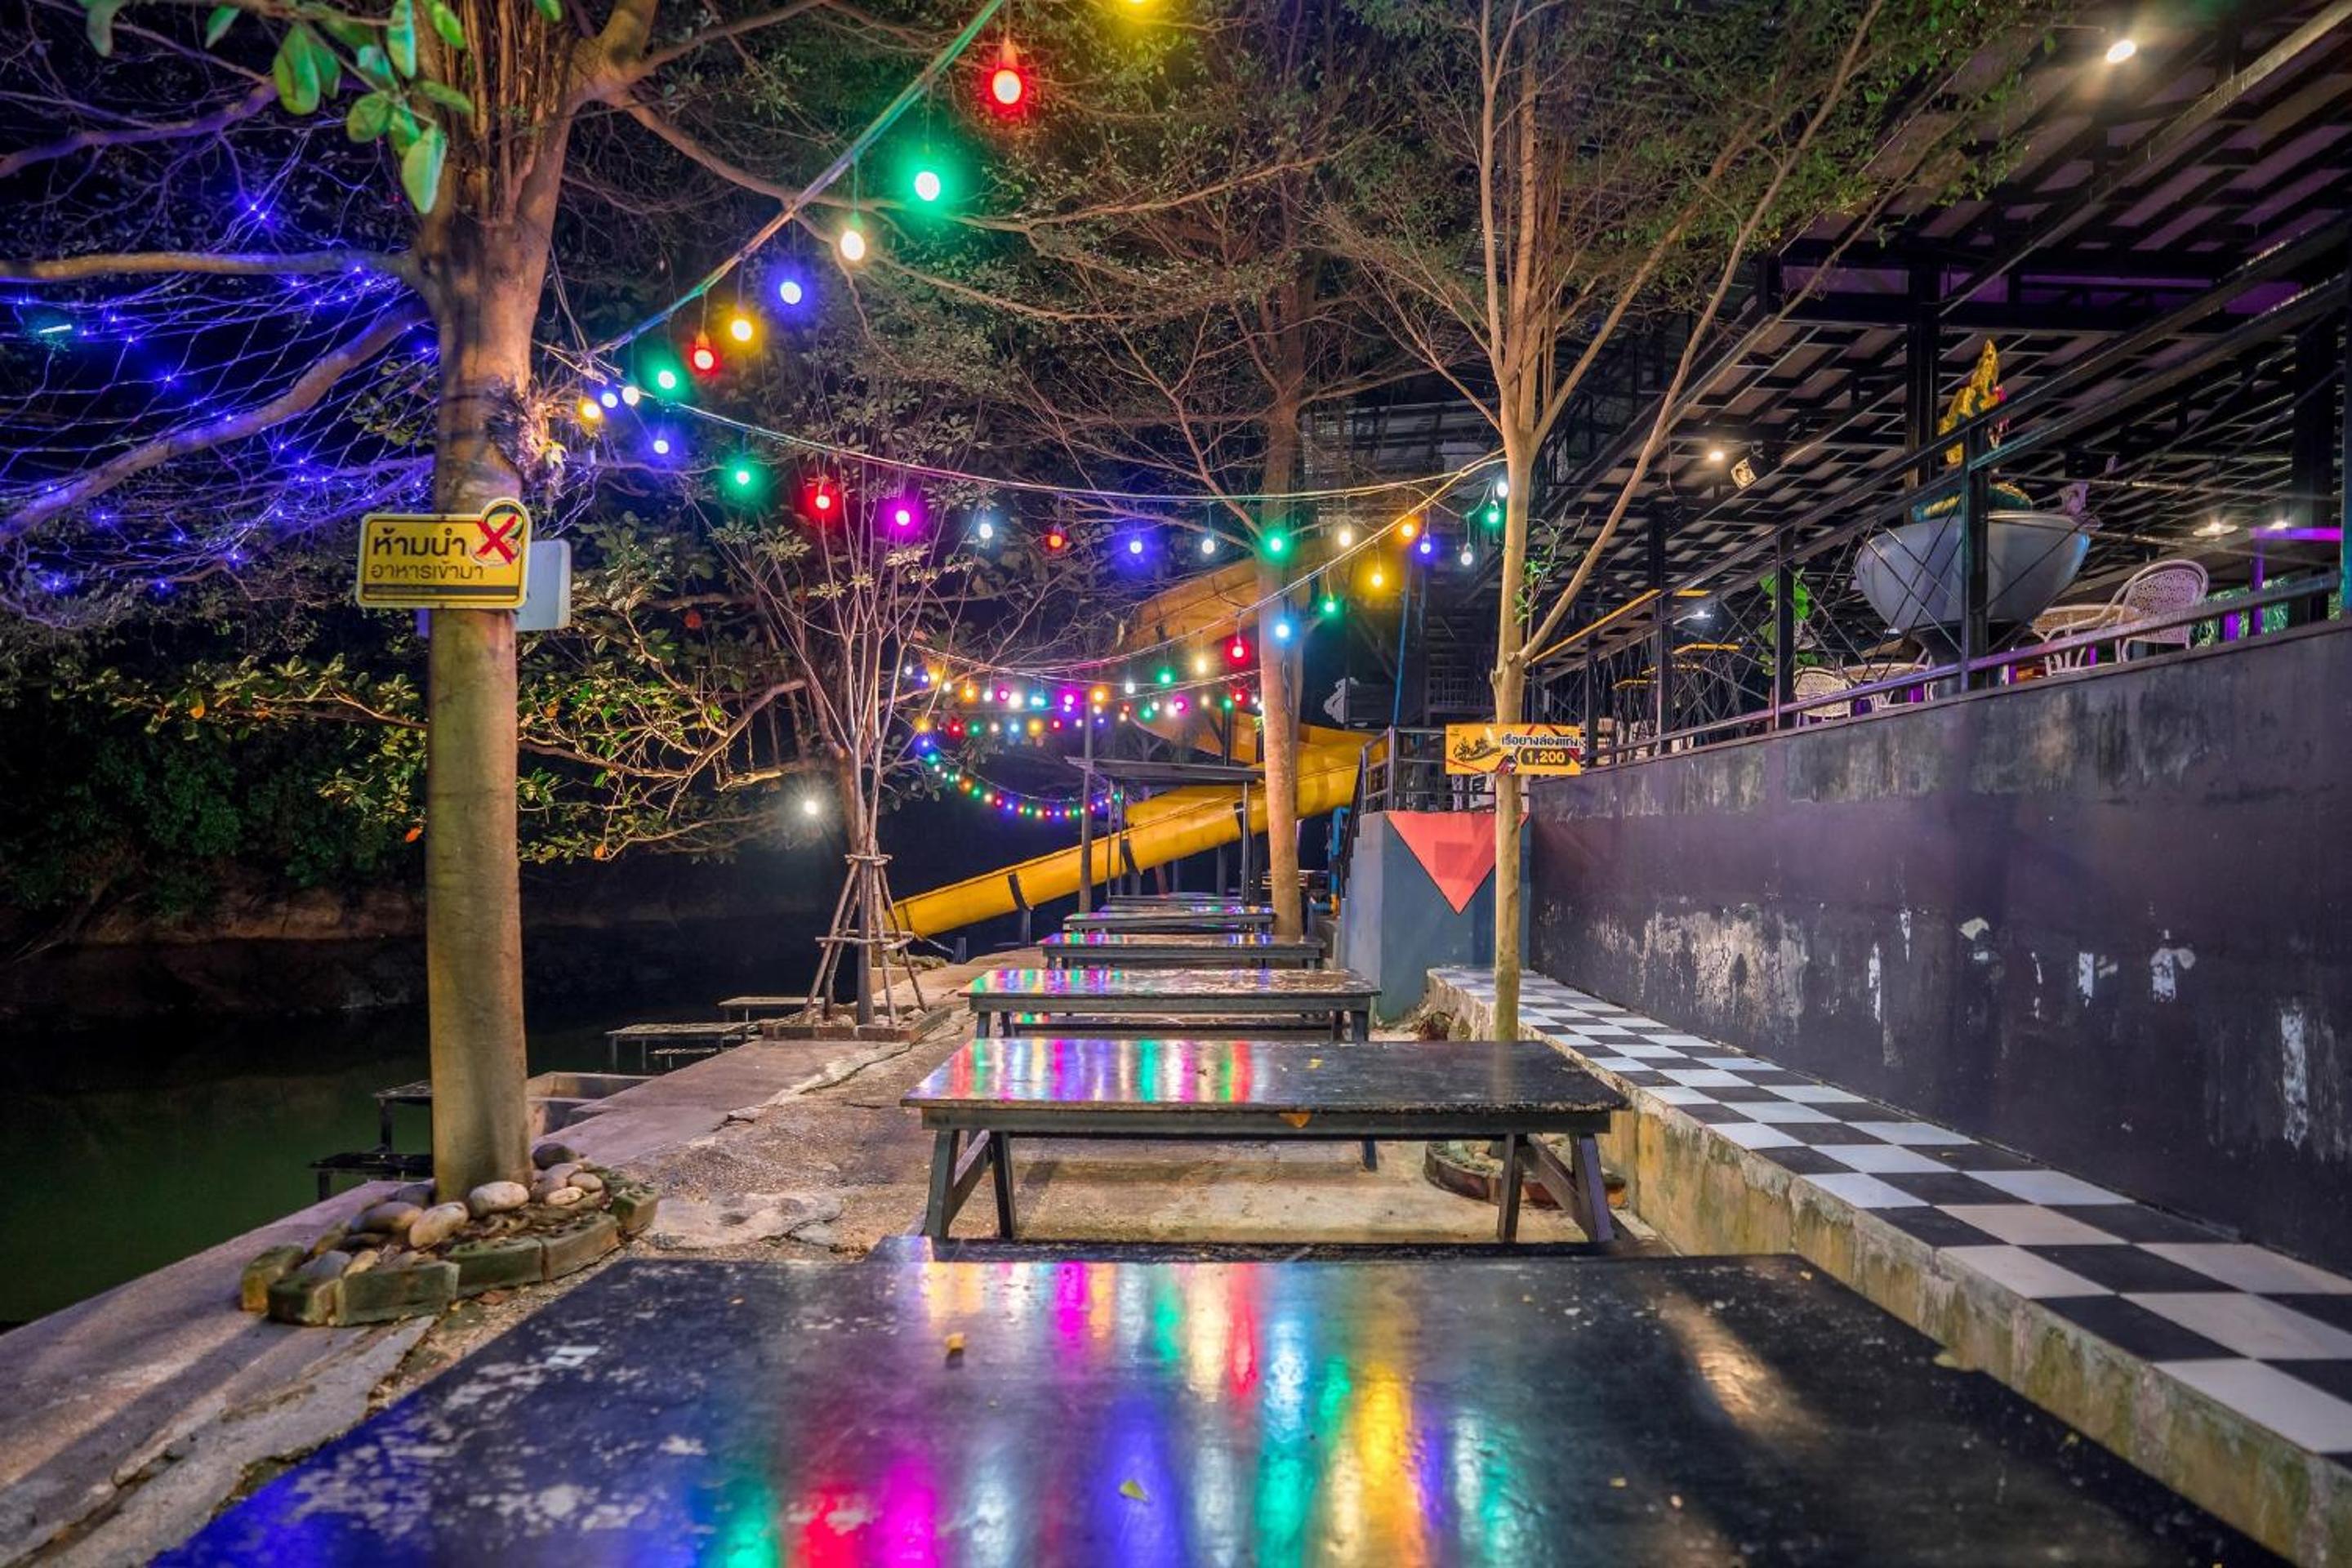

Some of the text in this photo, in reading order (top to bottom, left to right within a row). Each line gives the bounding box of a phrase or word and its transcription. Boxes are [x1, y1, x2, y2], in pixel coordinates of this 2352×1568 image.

[372, 527, 466, 556] ห้ามนำ
[370, 561, 484, 580] อาหารเข้ามา
[1526, 751, 1566, 765] 1,200
